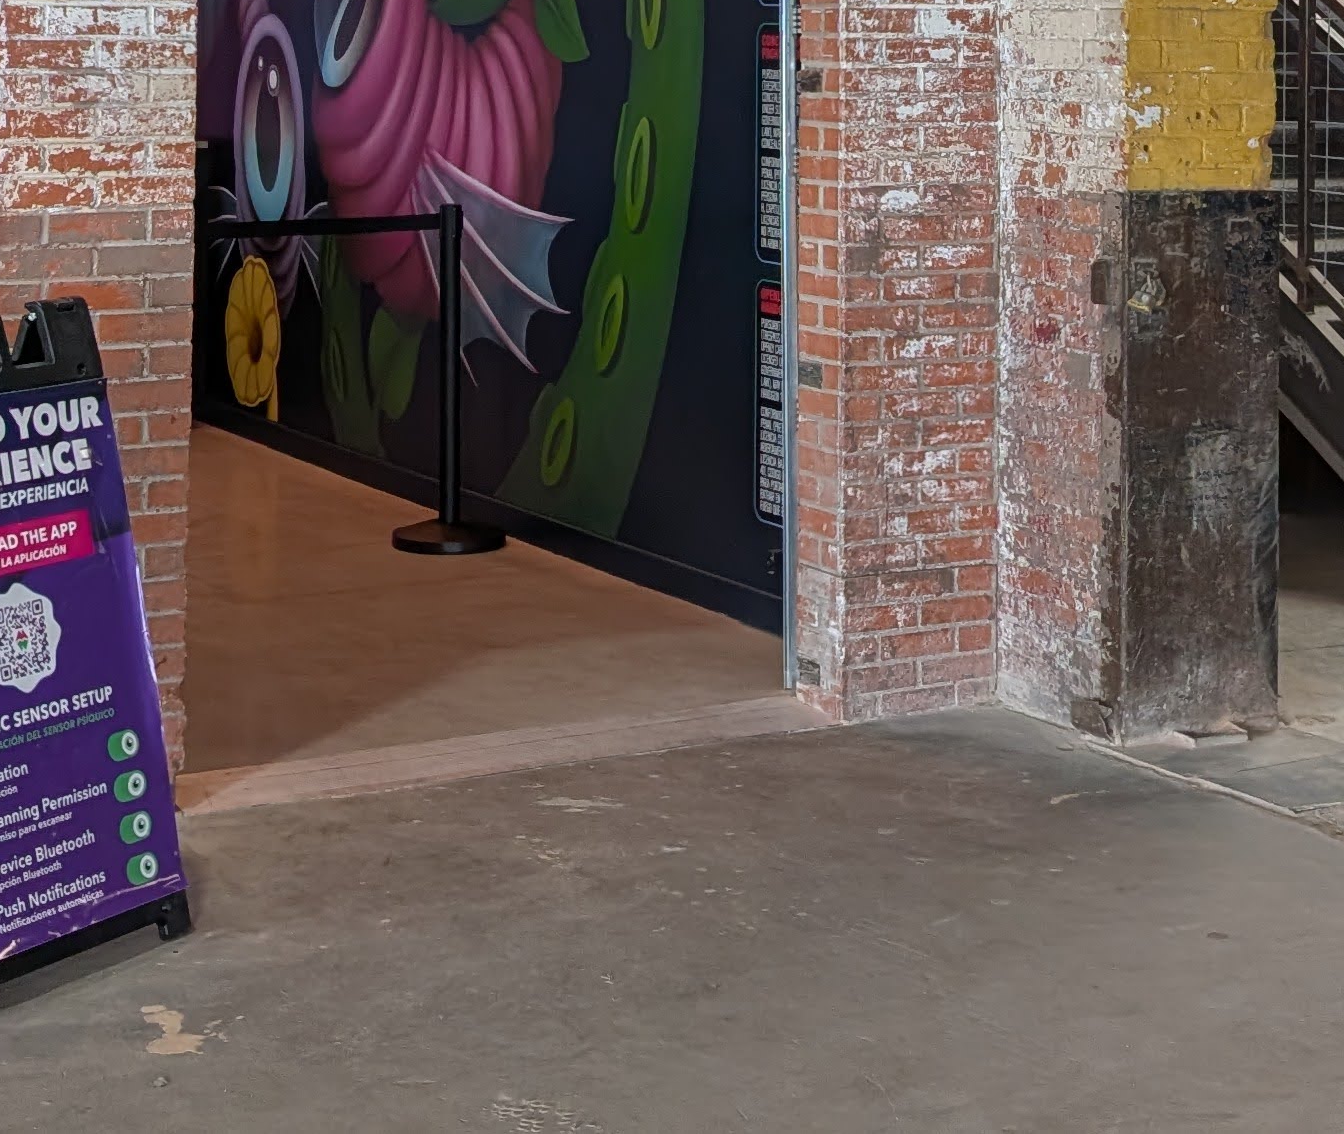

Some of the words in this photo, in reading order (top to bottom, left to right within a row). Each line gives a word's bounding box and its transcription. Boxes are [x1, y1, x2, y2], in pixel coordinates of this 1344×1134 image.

[9, 396, 103, 439] YOUR
[0, 477, 89, 510] EXPERIENCIA
[20, 530, 48, 545] THE
[51, 521, 77, 540] APP
[14, 544, 66, 565] APLICACIÓN
[13, 699, 69, 727] SENSOR
[72, 686, 113, 711] SETUP
[26, 730, 41, 741] DEL
[43, 719, 75, 737] SENSOR
[41, 782, 107, 813] Permission
[18, 824, 36, 838] para
[38, 812, 72, 829] escanear
[35, 829, 96, 862] Bluetooth
[23, 860, 62, 881] Bluetooth
[28, 871, 106, 909] Notifications
[0, 907, 56, 934] Notificaciones
[58, 889, 104, 911] automáticas
